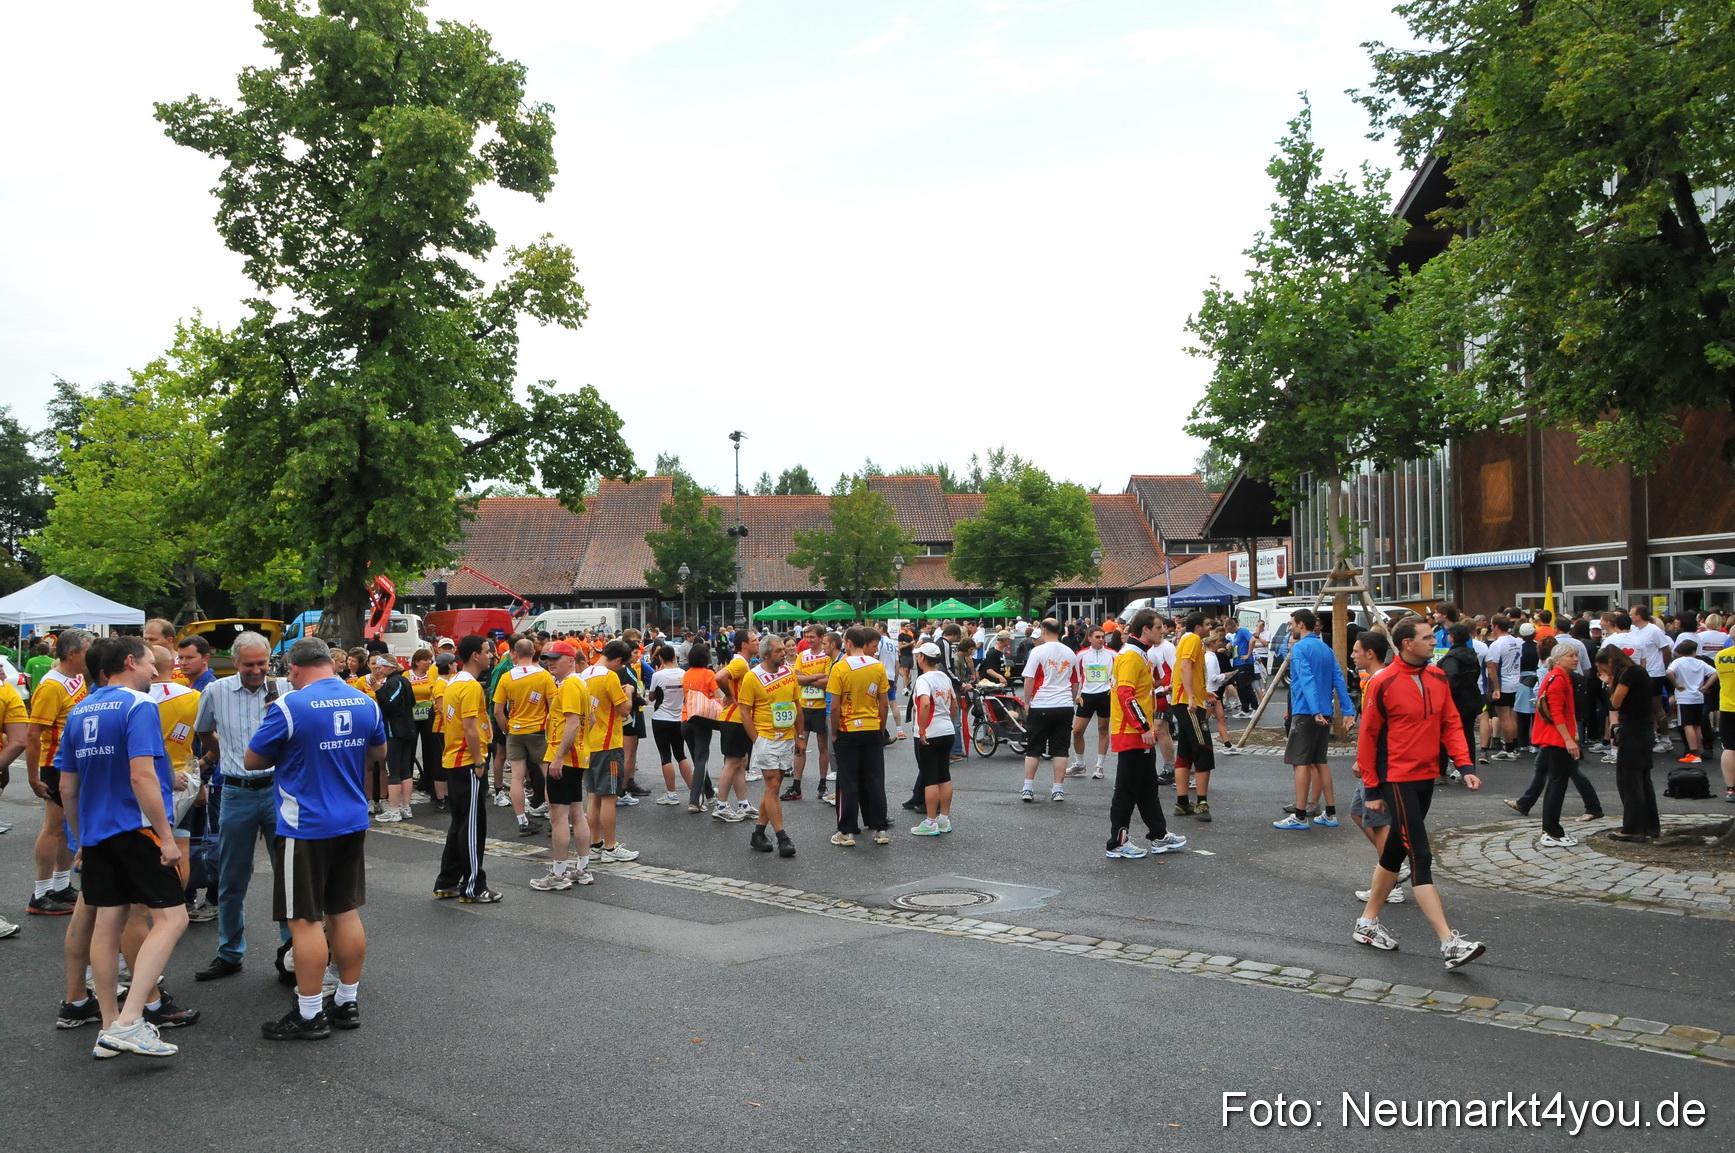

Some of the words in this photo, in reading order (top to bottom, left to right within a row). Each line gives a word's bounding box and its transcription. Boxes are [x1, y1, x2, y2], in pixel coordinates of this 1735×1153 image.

[886, 642, 894, 653] 13
[1091, 671, 1101, 679] 38
[765, 683, 782, 694] MAX
[782, 677, 796, 686] BÖGL
[310, 697, 366, 709] GANSBRÄU
[775, 710, 793, 721] 393
[319, 740, 343, 751] GIBT
[344, 738, 365, 748] GAS!
[75, 747, 92, 758] GIBT
[91, 745, 115, 756] GAS!
